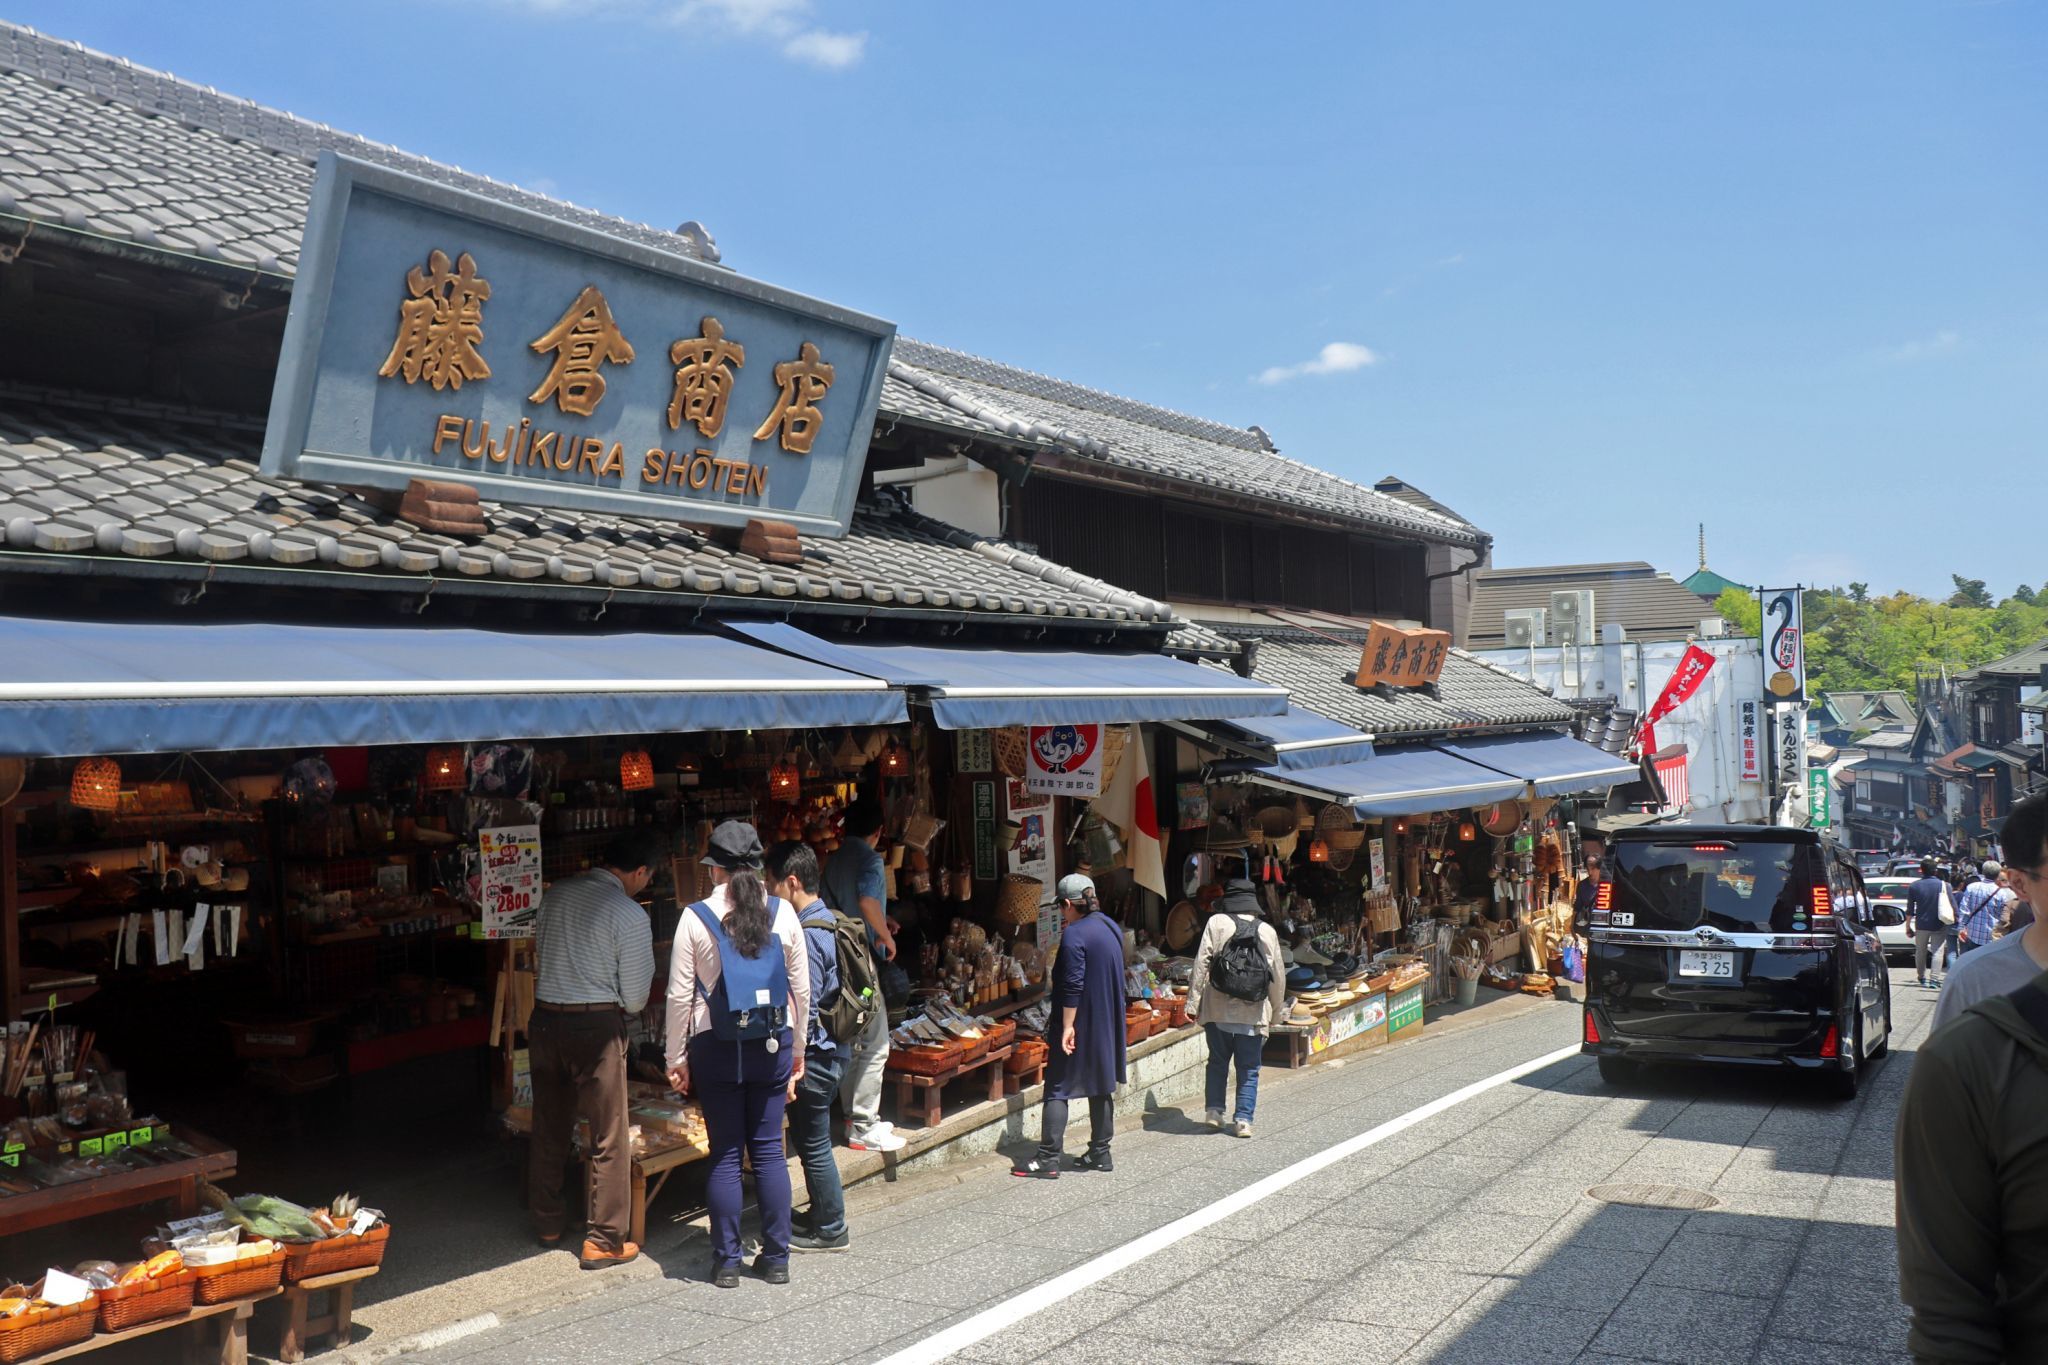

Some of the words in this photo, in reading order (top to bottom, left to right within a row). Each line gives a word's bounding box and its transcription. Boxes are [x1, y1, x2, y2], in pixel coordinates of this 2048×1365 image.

[379, 249, 834, 454] 藤倉商店
[641, 447, 769, 496] SHŌTEN
[977, 784, 992, 818] 通学路
[1028, 778, 1095, 790] 天皇陛下御即位
